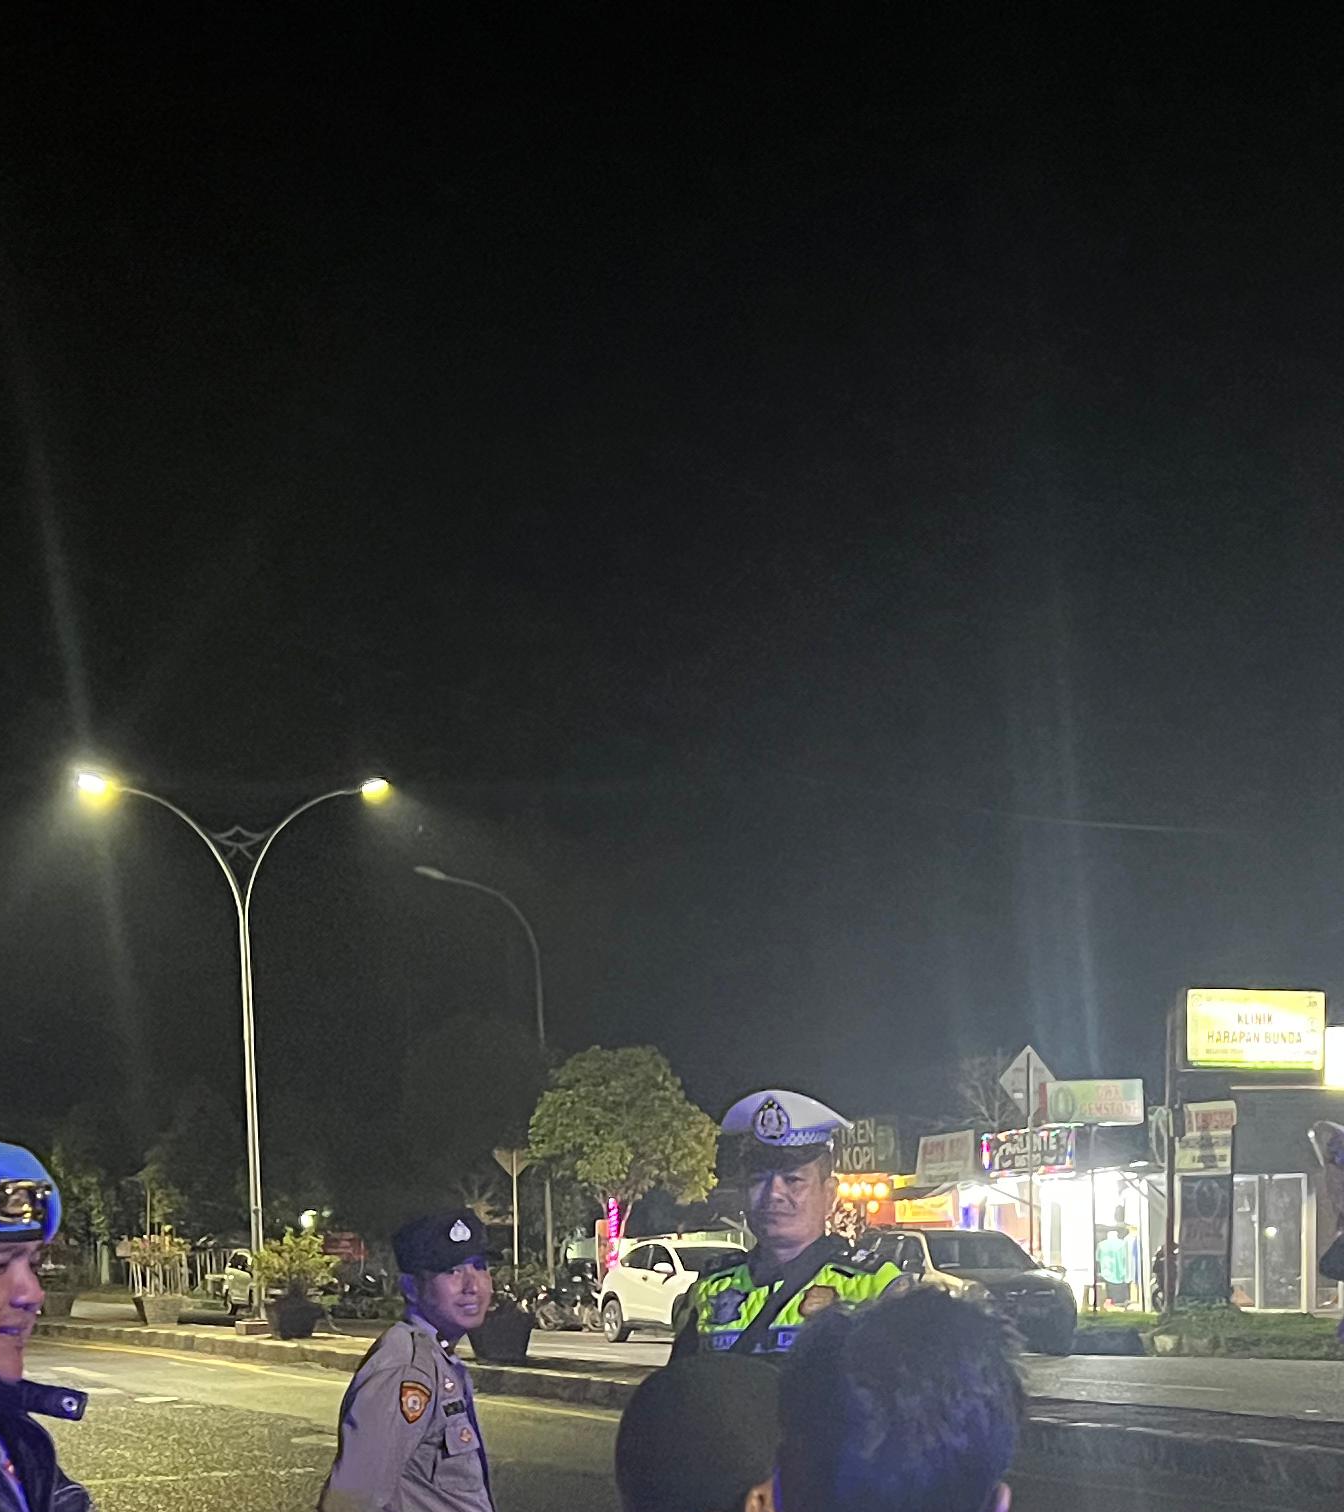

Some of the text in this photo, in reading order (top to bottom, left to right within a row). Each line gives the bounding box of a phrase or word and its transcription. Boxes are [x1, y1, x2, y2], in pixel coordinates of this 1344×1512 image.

[1237, 1013, 1273, 1025] KLINIK
[1207, 1031, 1302, 1044] HARAPAN BUNDA
[842, 1146, 875, 1170] KOPI
